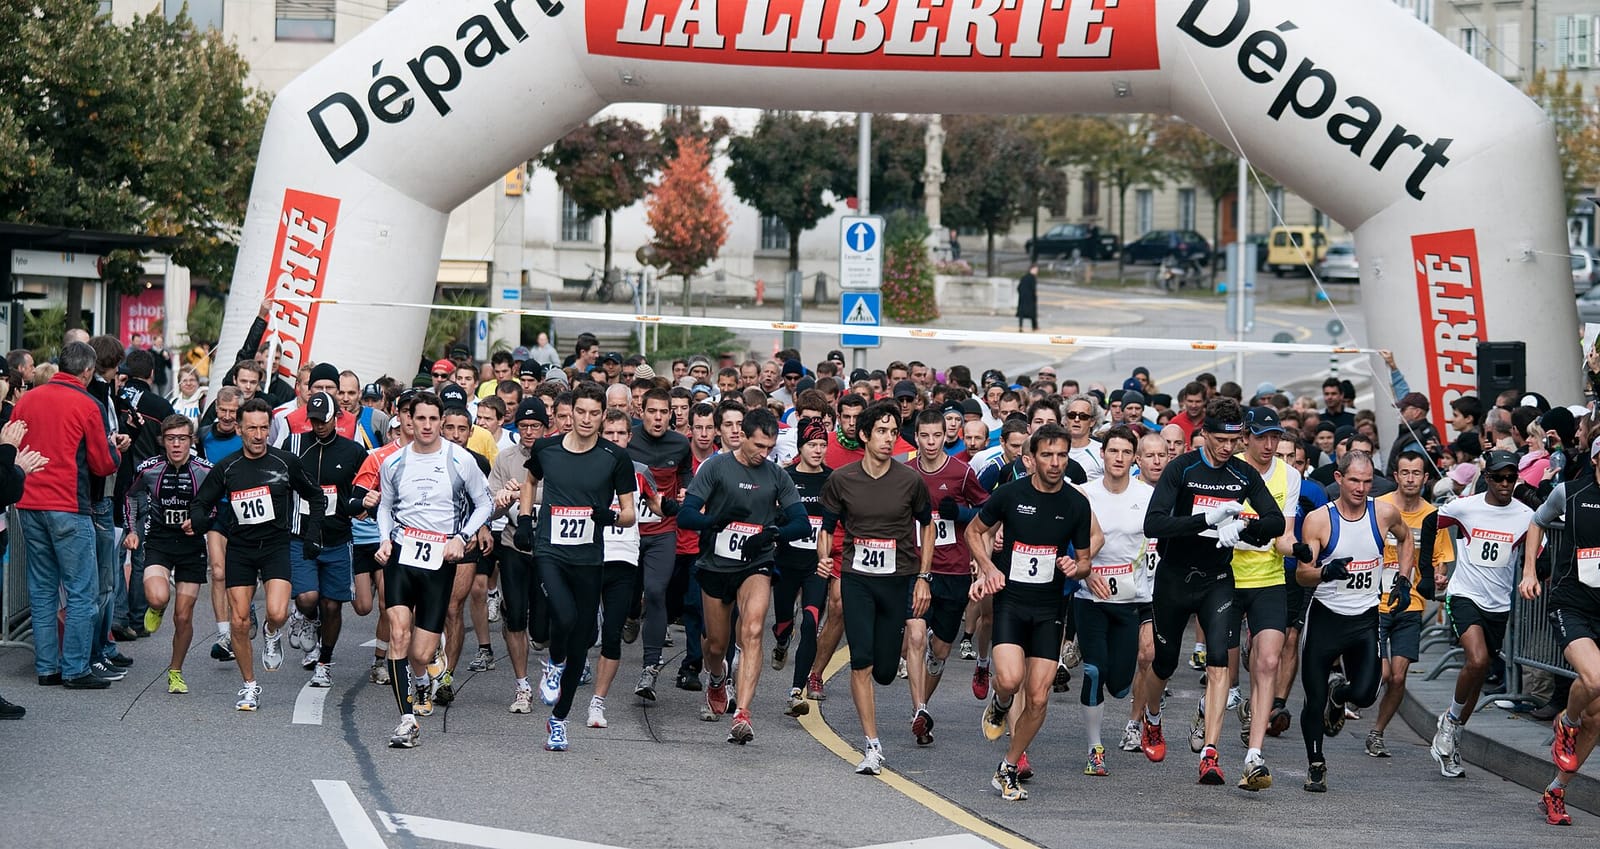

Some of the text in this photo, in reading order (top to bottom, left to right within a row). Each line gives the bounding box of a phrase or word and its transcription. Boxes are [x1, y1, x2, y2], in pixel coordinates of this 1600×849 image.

[616, 0, 725, 50] LA
[1176, 0, 1454, 201] Départ
[129, 303, 165, 319] shop
[128, 317, 149, 333] till
[1187, 481, 1226, 491] SALOMON
[240, 498, 265, 519] 216
[1196, 497, 1208, 506] LA
[166, 511, 188, 524] 181
[554, 508, 564, 516] LA
[407, 528, 416, 536] LA
[560, 518, 586, 538] 227
[935, 520, 948, 540] 8
[1474, 529, 1484, 537] LA
[856, 538, 866, 546] LA
[1015, 544, 1025, 552] LA
[414, 541, 432, 562] 73
[861, 548, 885, 568] 241
[1481, 541, 1499, 561] 86
[1581, 551, 1591, 559] LA
[1028, 557, 1039, 577] 3
[1108, 577, 1118, 596] 8
[1346, 571, 1373, 590] 285
